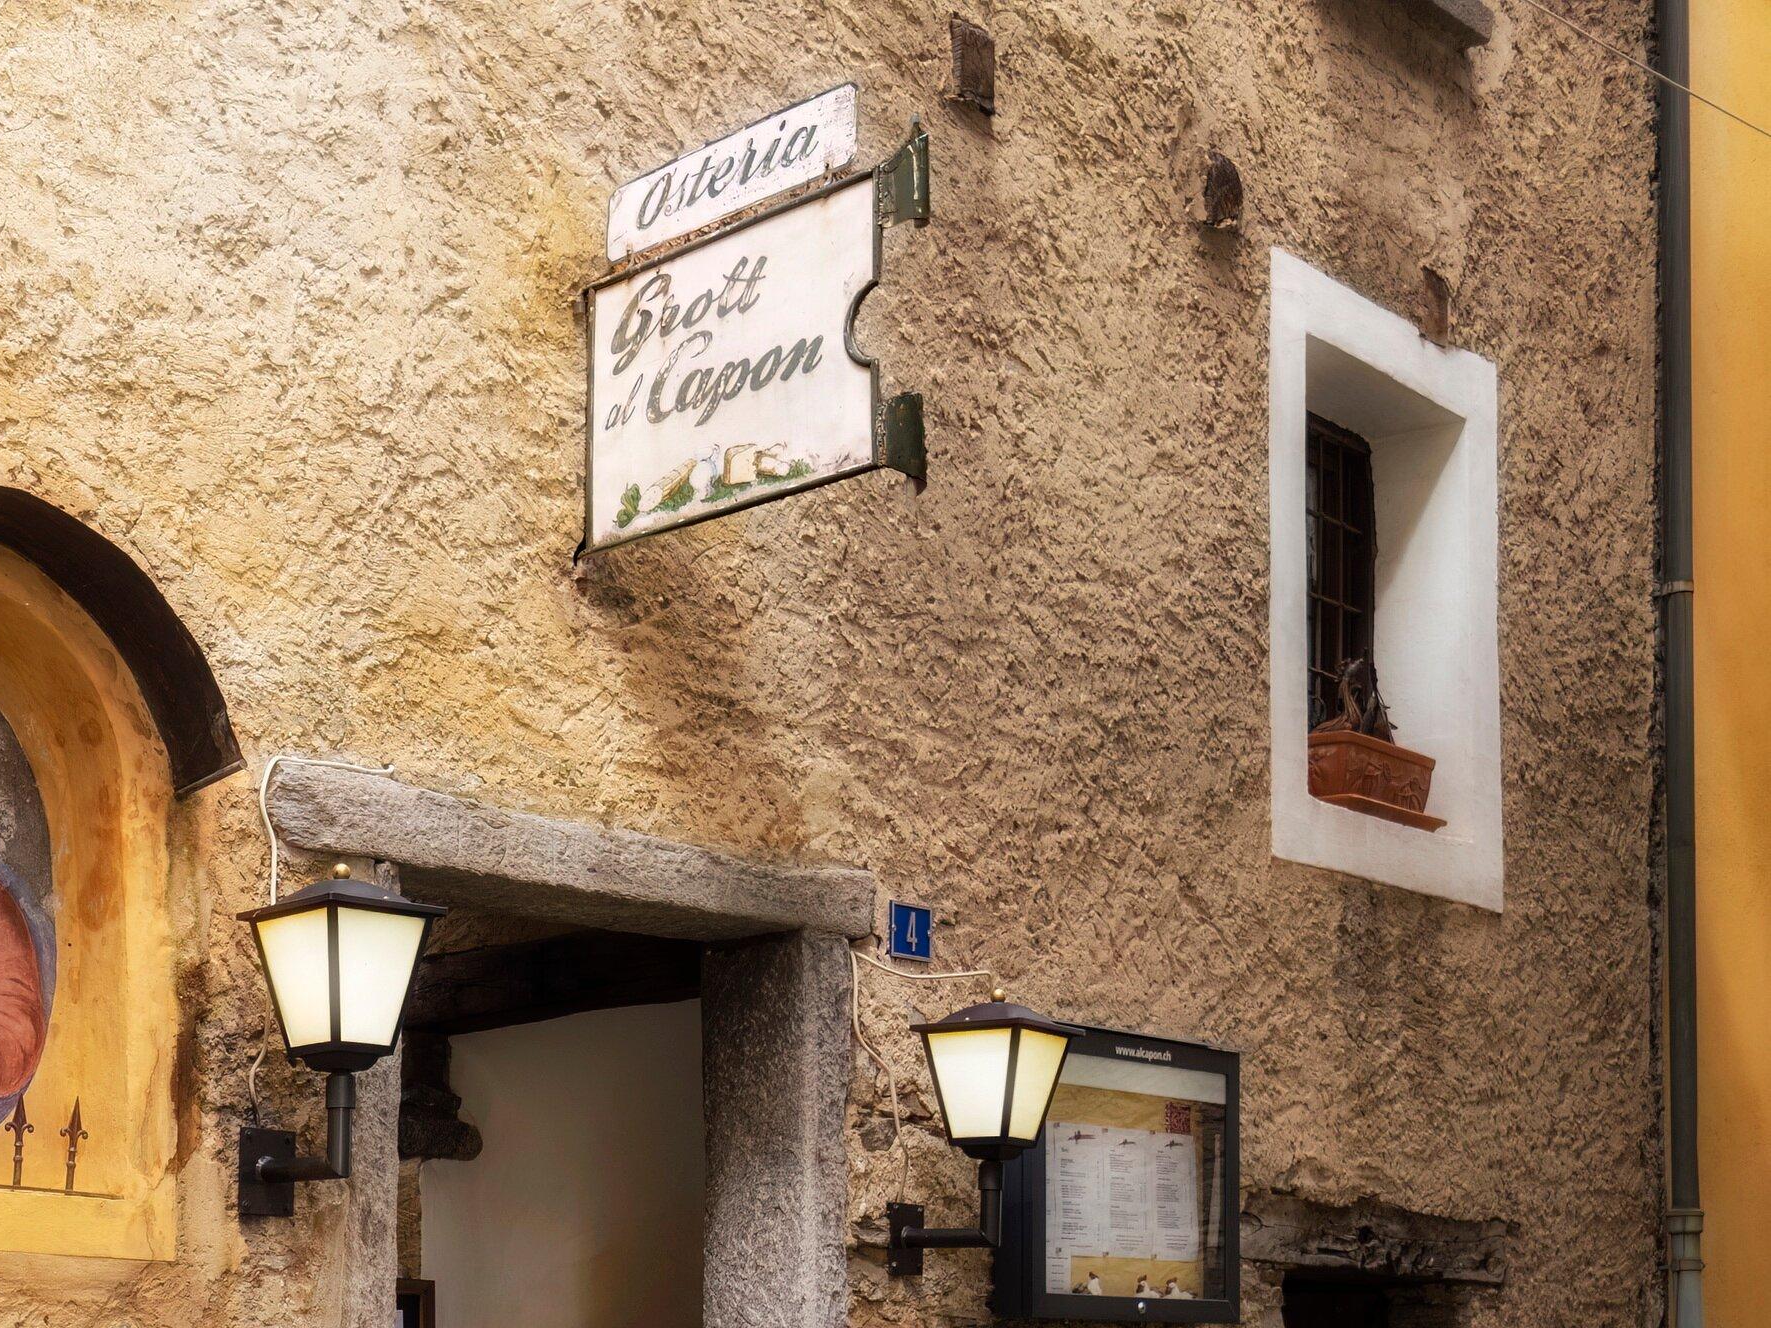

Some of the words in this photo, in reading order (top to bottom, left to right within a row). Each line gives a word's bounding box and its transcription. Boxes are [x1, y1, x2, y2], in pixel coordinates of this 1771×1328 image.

[636, 119, 820, 231] Osteria
[610, 255, 767, 375] Grott
[605, 372, 645, 431] al
[645, 330, 823, 427] Capon
[907, 911, 918, 952] 4
[1115, 1045, 1171, 1062] www.alcapon.ch
